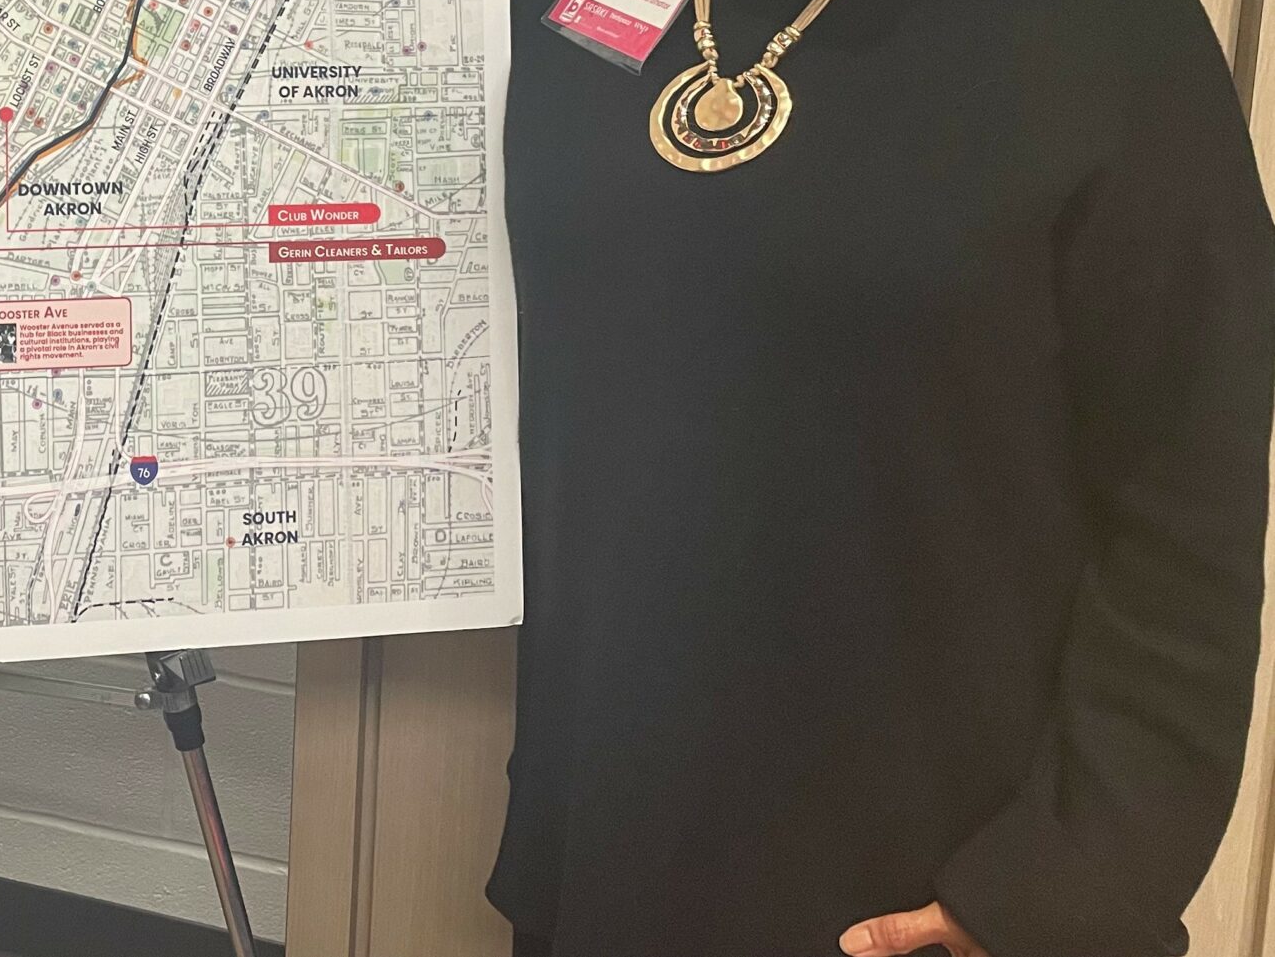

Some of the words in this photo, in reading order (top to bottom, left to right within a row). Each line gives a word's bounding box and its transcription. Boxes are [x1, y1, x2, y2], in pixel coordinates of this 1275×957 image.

[7, 18, 21, 32] ST
[204, 37, 235, 92] BROADWAY
[271, 65, 362, 79] UNIVERSITY
[9, 68, 35, 108] LOCUST
[29, 53, 42, 69] ST
[278, 85, 299, 98] OF
[303, 85, 358, 98] AKRON
[112, 124, 131, 151] MAIN
[125, 110, 137, 124] ST
[134, 139, 153, 164] HIGH
[147, 124, 159, 139] ST
[19, 182, 123, 196] DOWNTOWN
[44, 202, 102, 216] AKRON
[371, 244, 382, 256] &
[253, 368, 327, 427] 39
[138, 468, 150, 478] 76
[242, 511, 296, 526] SOUTH
[242, 530, 298, 546] AKRON
